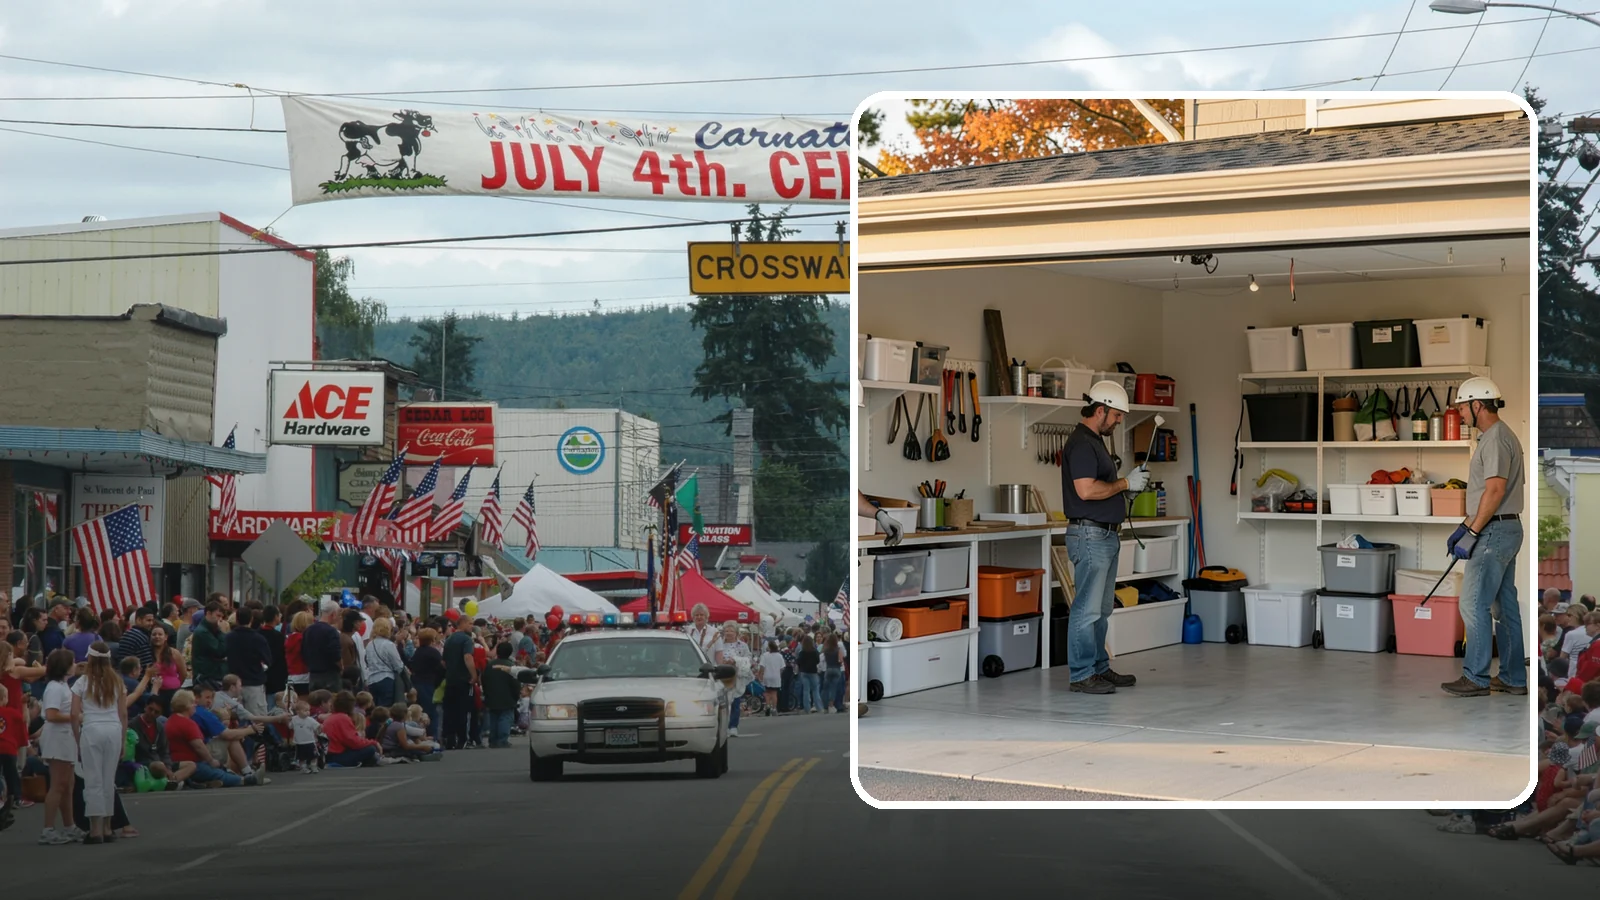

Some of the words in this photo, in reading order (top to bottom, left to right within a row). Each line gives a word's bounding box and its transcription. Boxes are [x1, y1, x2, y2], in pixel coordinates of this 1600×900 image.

[694, 121, 850, 150] Carnat
[481, 141, 605, 192] JULY
[632, 150, 746, 198] 4th.
[697, 254, 850, 280] CROSSWA
[283, 380, 373, 419] ACE
[406, 409, 452, 421] CEDAR
[283, 421, 370, 436] Hardware
[416, 428, 477, 447] Coca-Cola
[83, 485, 93, 494] St.
[95, 485, 124, 494] Vincent
[126, 486, 136, 495] de
[137, 486, 155, 495] Paul
[212, 516, 330, 535] HARDARE
[688, 526, 741, 535] CRNATION
[699, 535, 730, 543] GLASS
